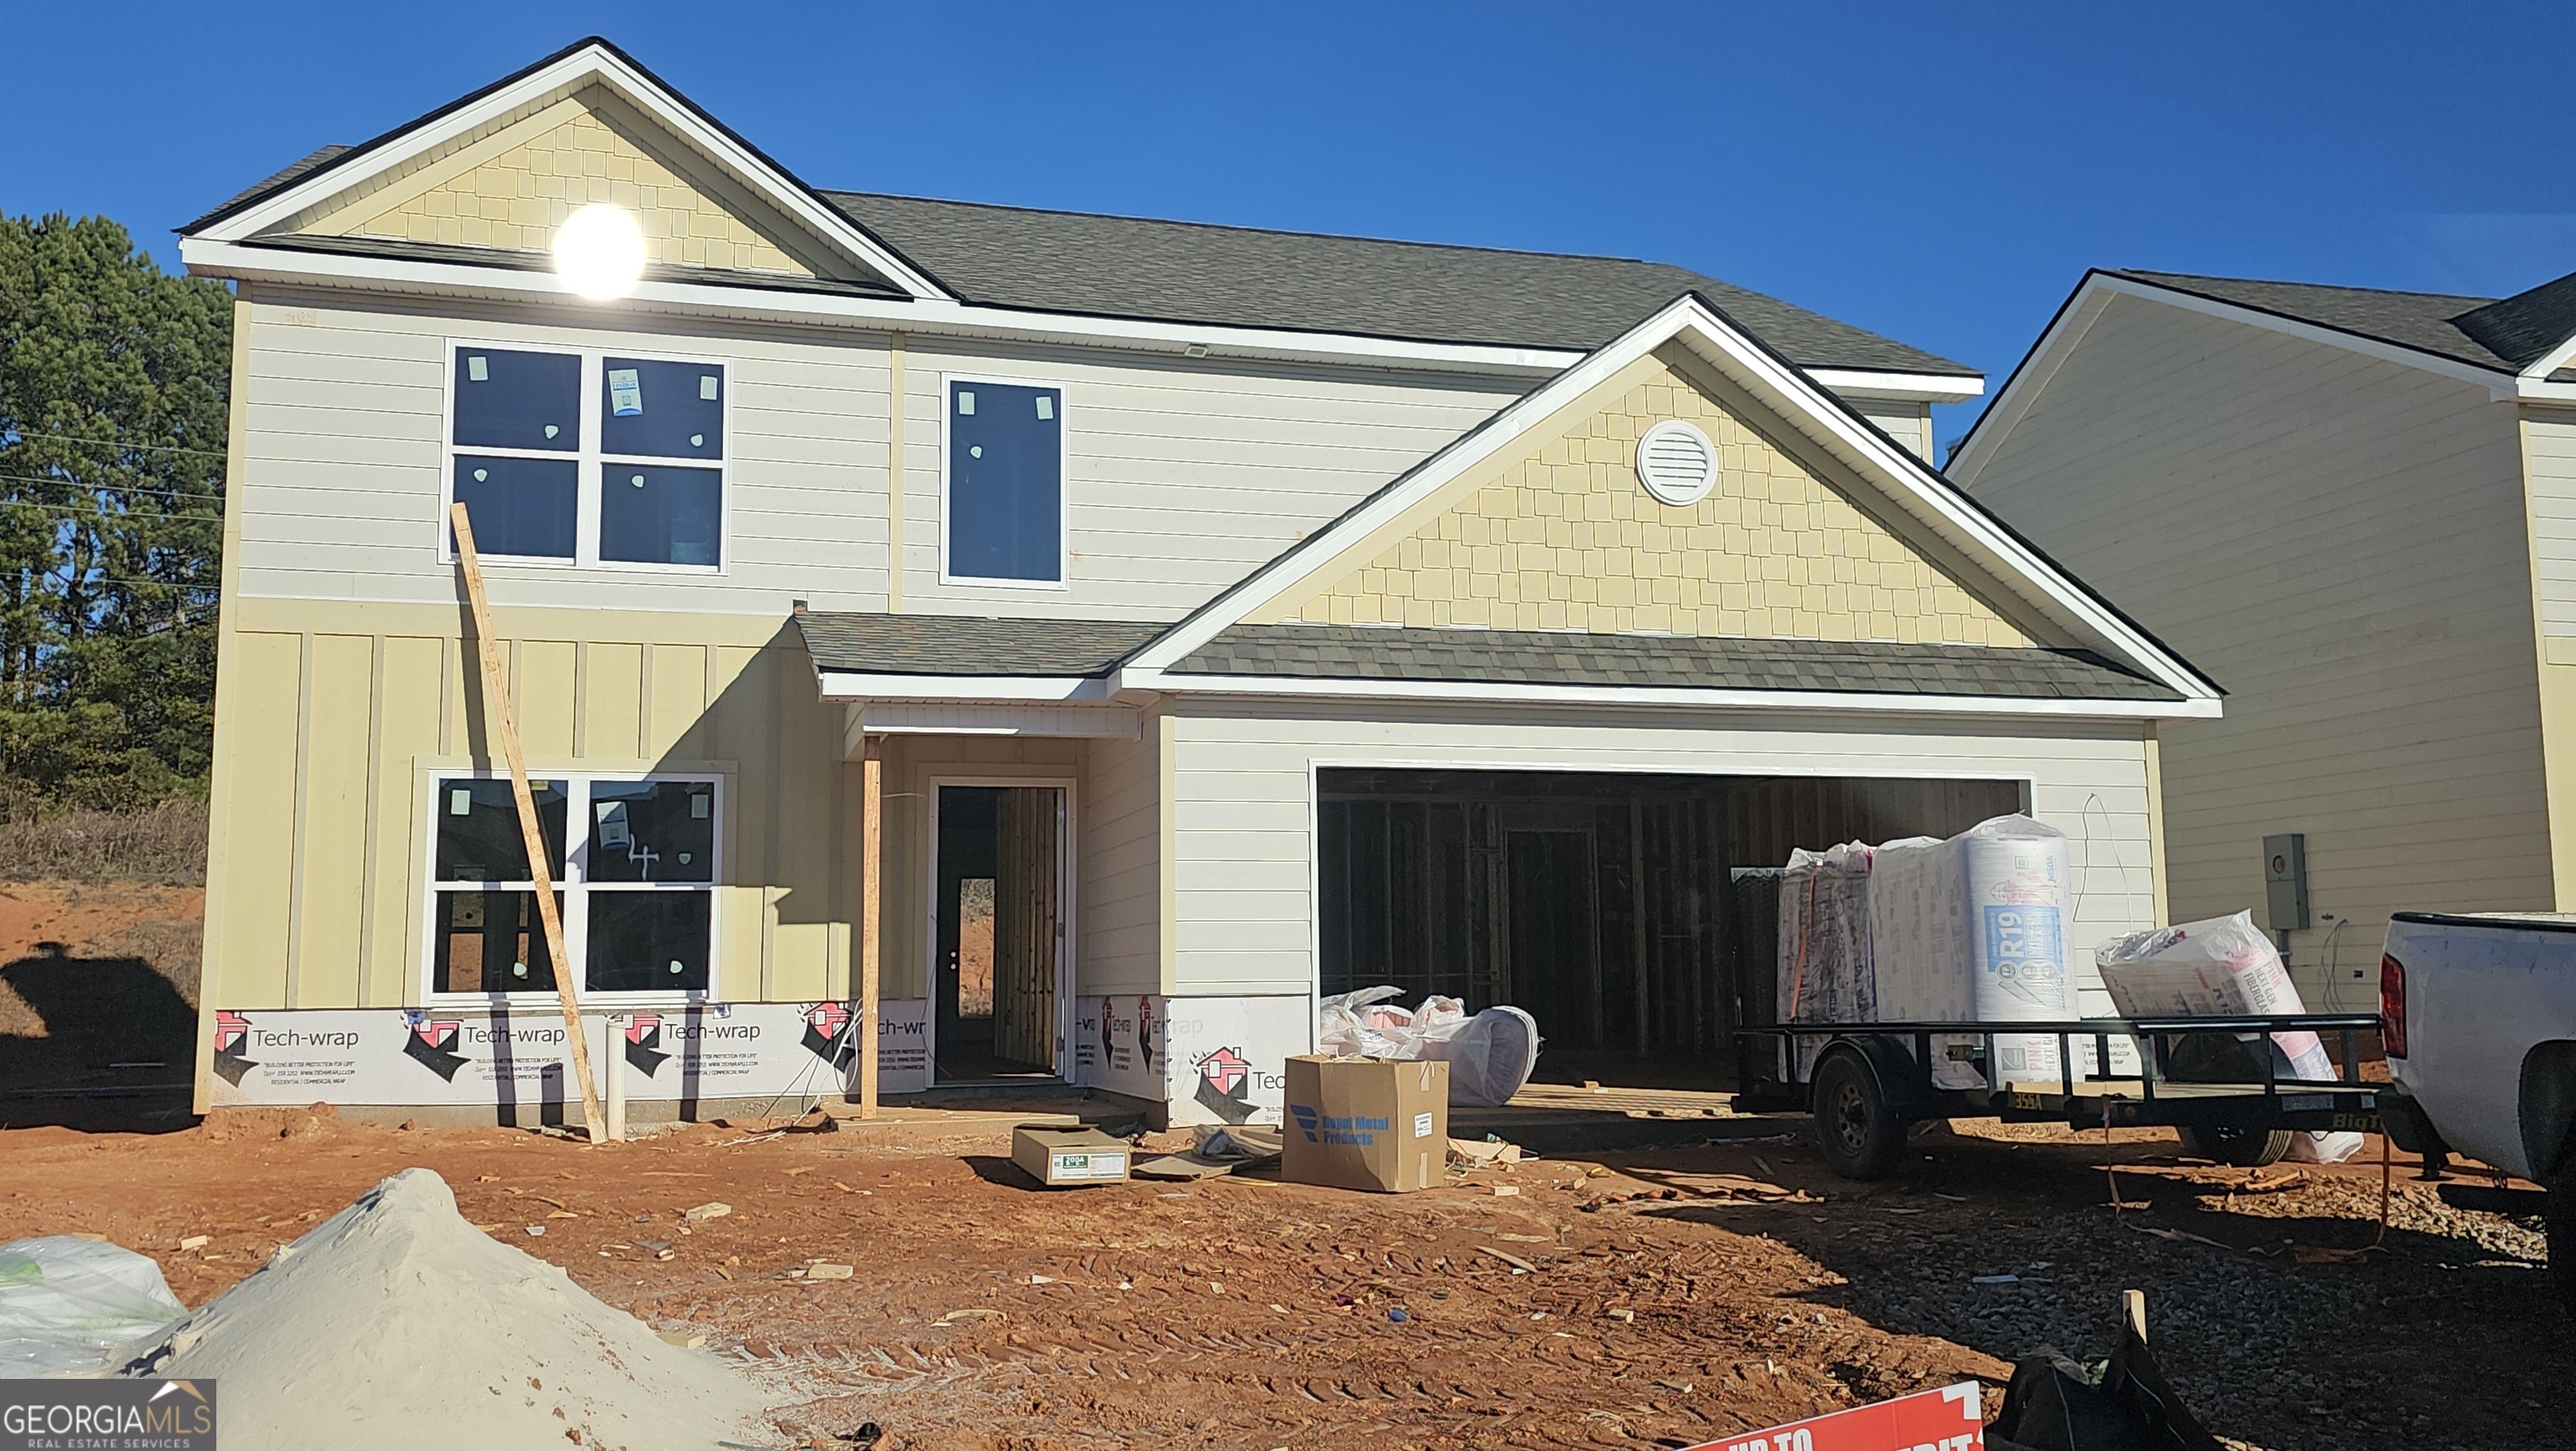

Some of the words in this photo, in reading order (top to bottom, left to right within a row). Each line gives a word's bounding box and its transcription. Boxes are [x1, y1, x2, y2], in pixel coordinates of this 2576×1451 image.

[1997, 912, 2024, 958] R19
[2264, 960, 2282, 988] PINK
[2255, 966, 2269, 987] NEXT
[2264, 987, 2278, 1005] GEN
[252, 1028, 359, 1050] Tech-wrap
[464, 1026, 565, 1046] Tech-wrap
[664, 1022, 761, 1042] Tech-wrap
[1253, 1072, 1285, 1090] Tec
[1355, 1116, 1389, 1131] Metal
[1323, 1131, 1374, 1145] Products
